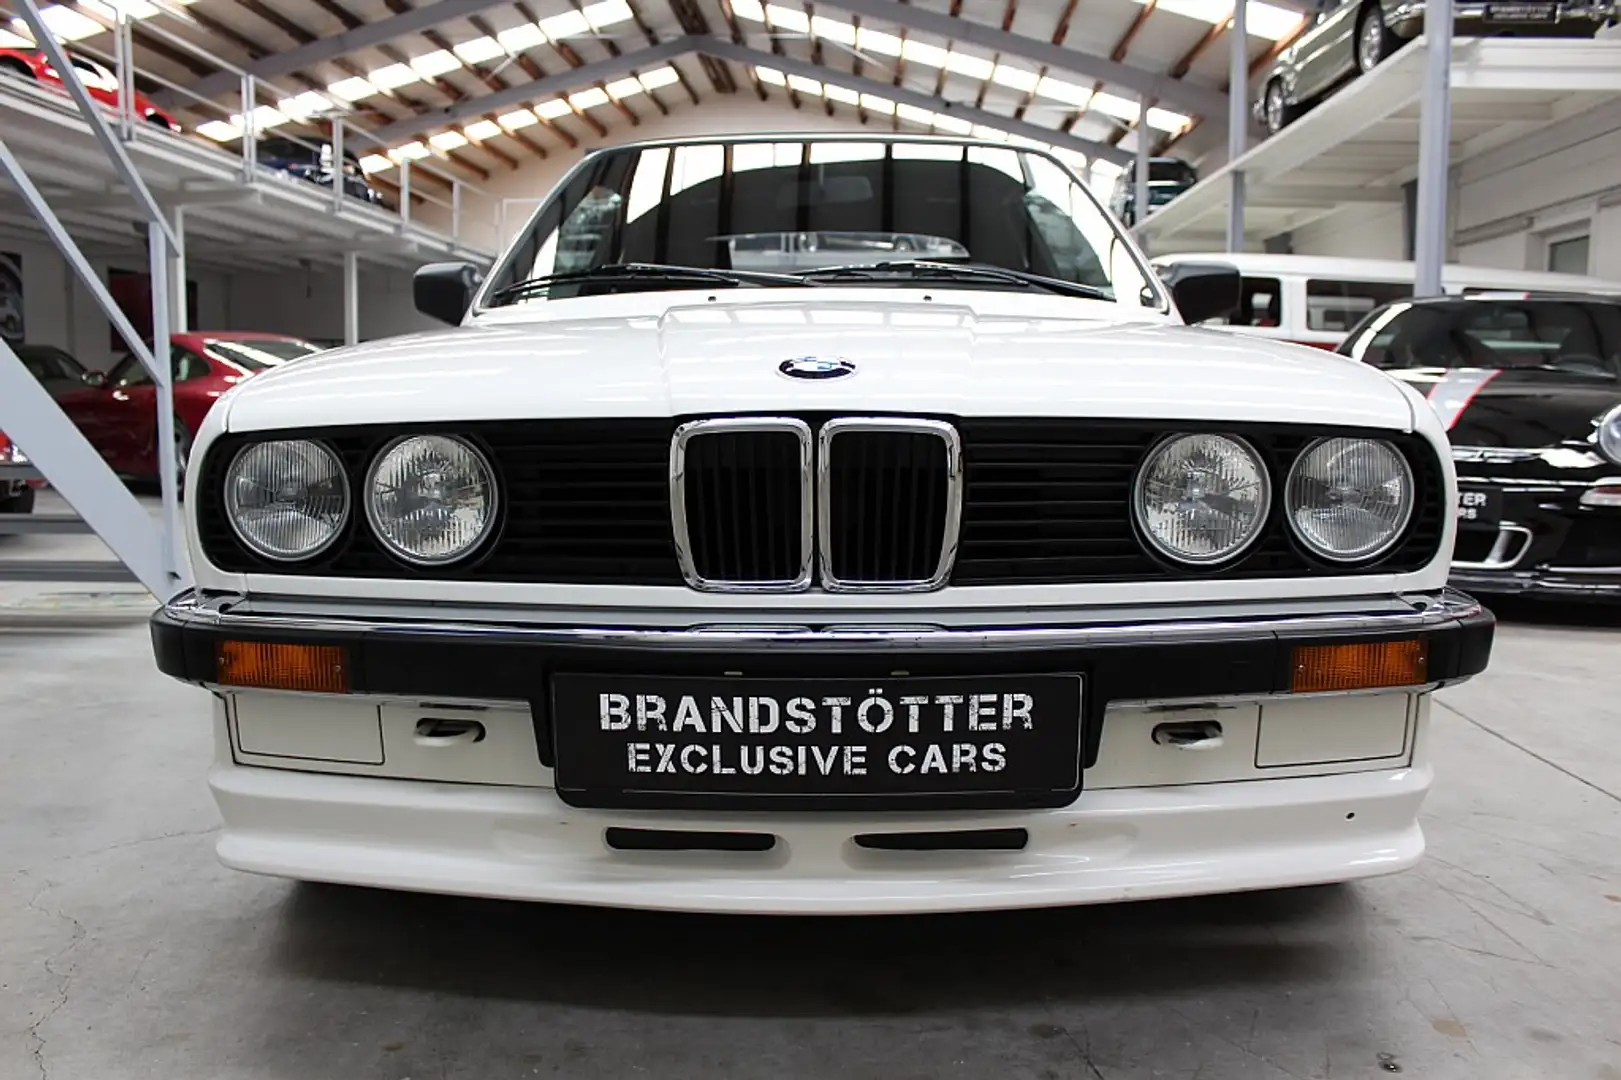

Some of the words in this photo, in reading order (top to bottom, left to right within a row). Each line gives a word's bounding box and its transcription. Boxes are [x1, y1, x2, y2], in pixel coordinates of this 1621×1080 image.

[599, 688, 1034, 734] BRANDSTÖTTER
[627, 742, 867, 775] EXCLUSIVE
[887, 742, 1006, 774] CARS
